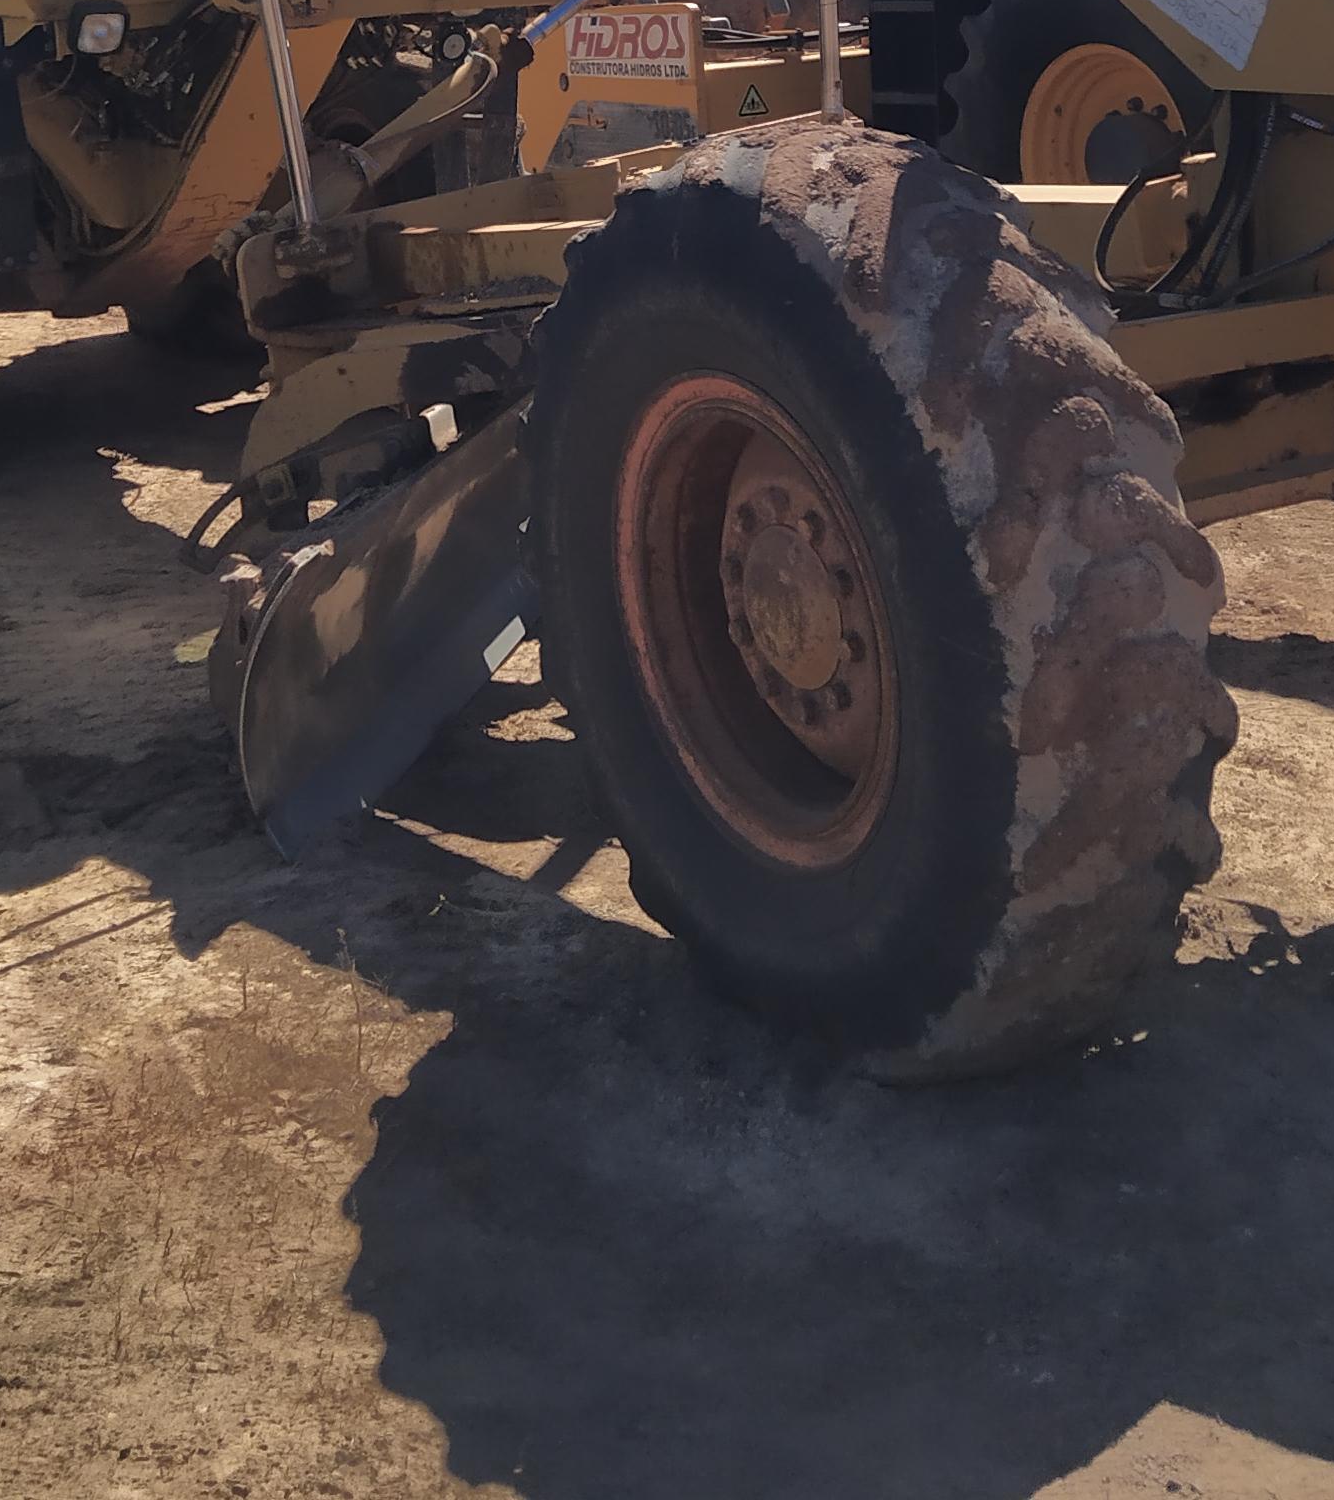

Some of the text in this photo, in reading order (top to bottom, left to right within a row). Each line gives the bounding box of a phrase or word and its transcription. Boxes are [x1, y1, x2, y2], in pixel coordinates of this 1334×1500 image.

[569, 61, 689, 78] CONSTRUTORA HIDROS LTDA.
